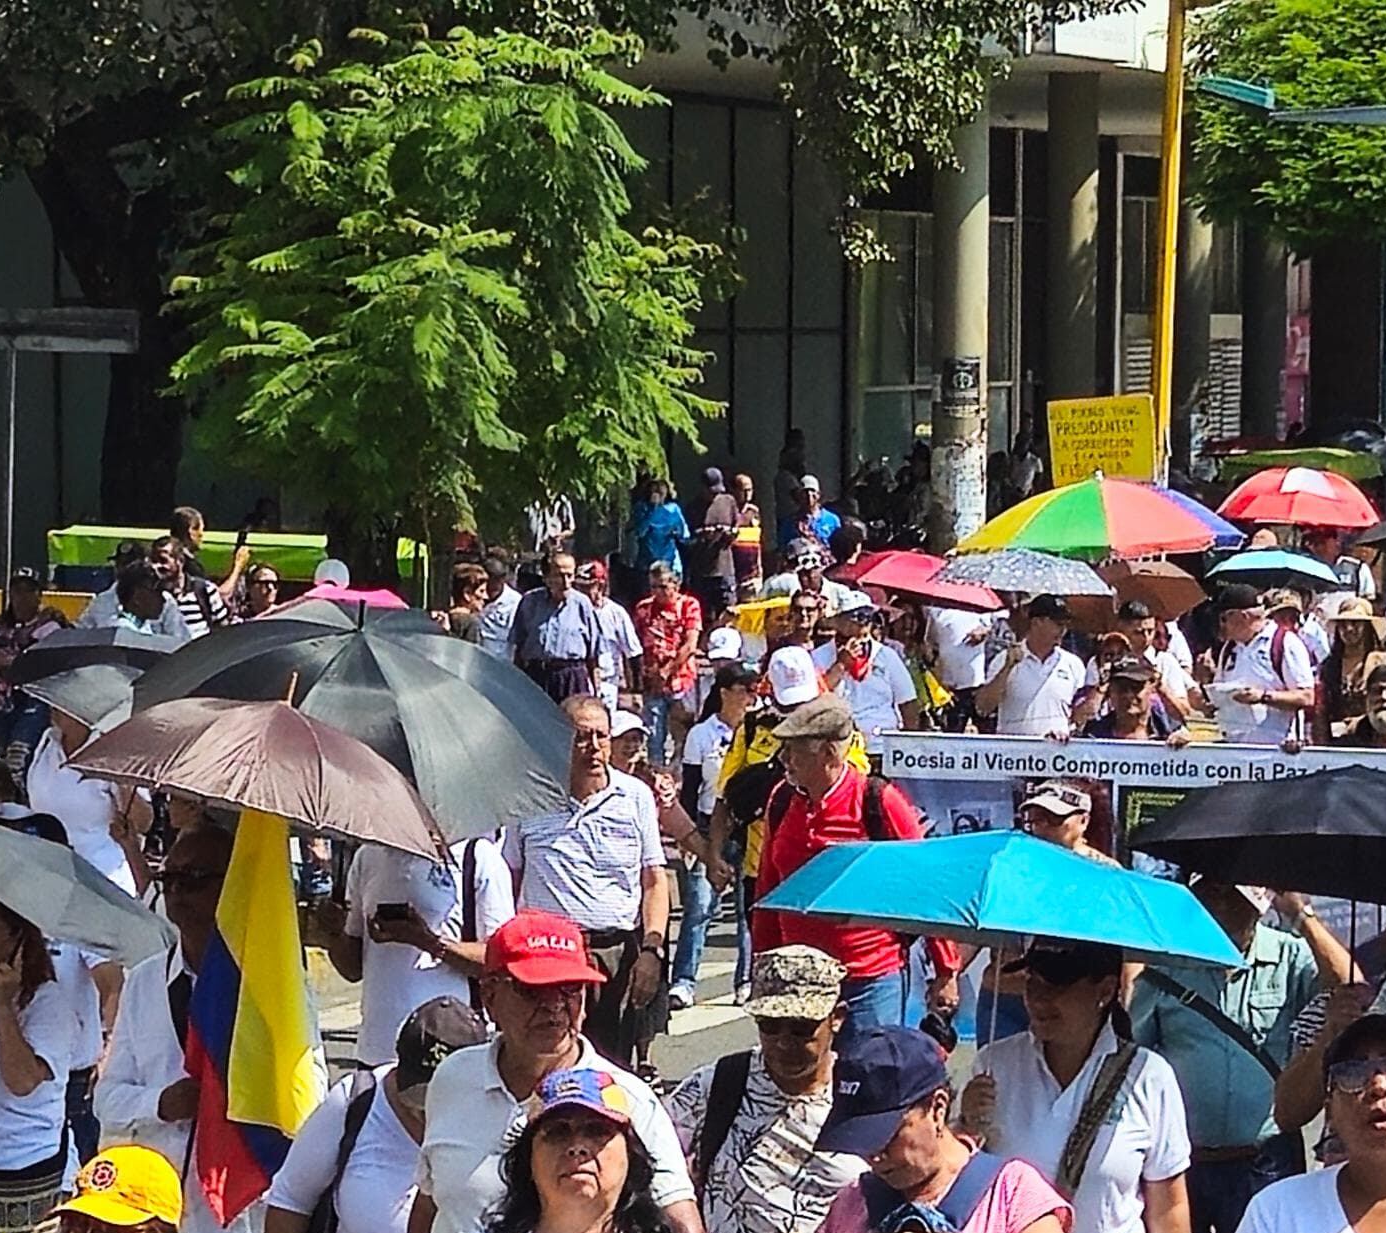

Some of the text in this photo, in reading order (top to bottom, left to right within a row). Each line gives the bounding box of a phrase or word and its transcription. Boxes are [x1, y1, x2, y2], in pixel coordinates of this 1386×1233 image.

[892, 750, 956, 769] Poesia
[962, 753, 978, 770] al
[985, 754, 1047, 772] Viento
[1052, 755, 1198, 778] Comprometida
[1205, 764, 1241, 780] con
[1249, 763, 1264, 780] la
[1273, 763, 1308, 780] Paz
